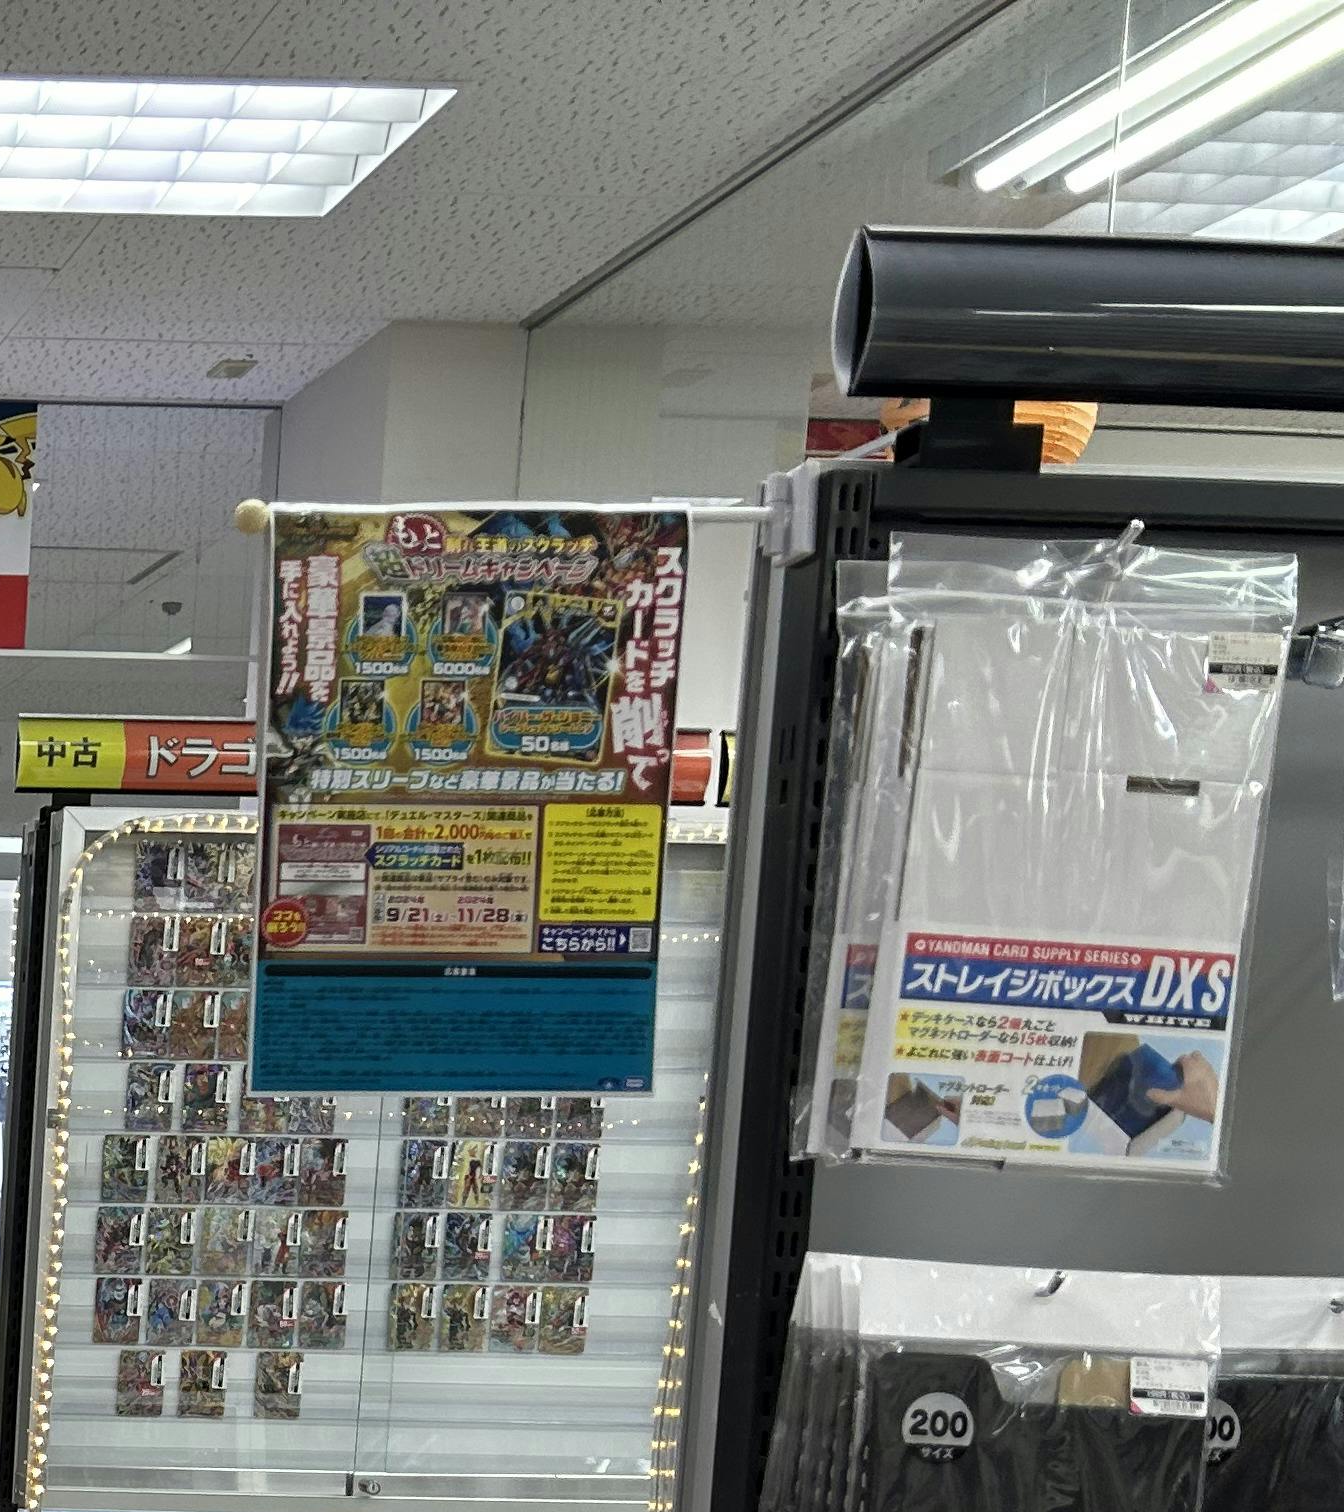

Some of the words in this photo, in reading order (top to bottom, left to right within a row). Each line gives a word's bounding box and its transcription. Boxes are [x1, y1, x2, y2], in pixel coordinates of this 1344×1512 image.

[650, 547, 684, 688] スクラッチ
[36, 735, 102, 769] 中古
[374, 852, 463, 868] スクラッチカード
[992, 943, 1030, 959] CARD
[1032, 945, 1082, 964] SUPPLY
[1083, 949, 1131, 965] SERIES
[906, 961, 1137, 1005] ストレイジボックス
[908, 1409, 969, 1439] 200
[918, 1445, 956, 1461] サイズ
